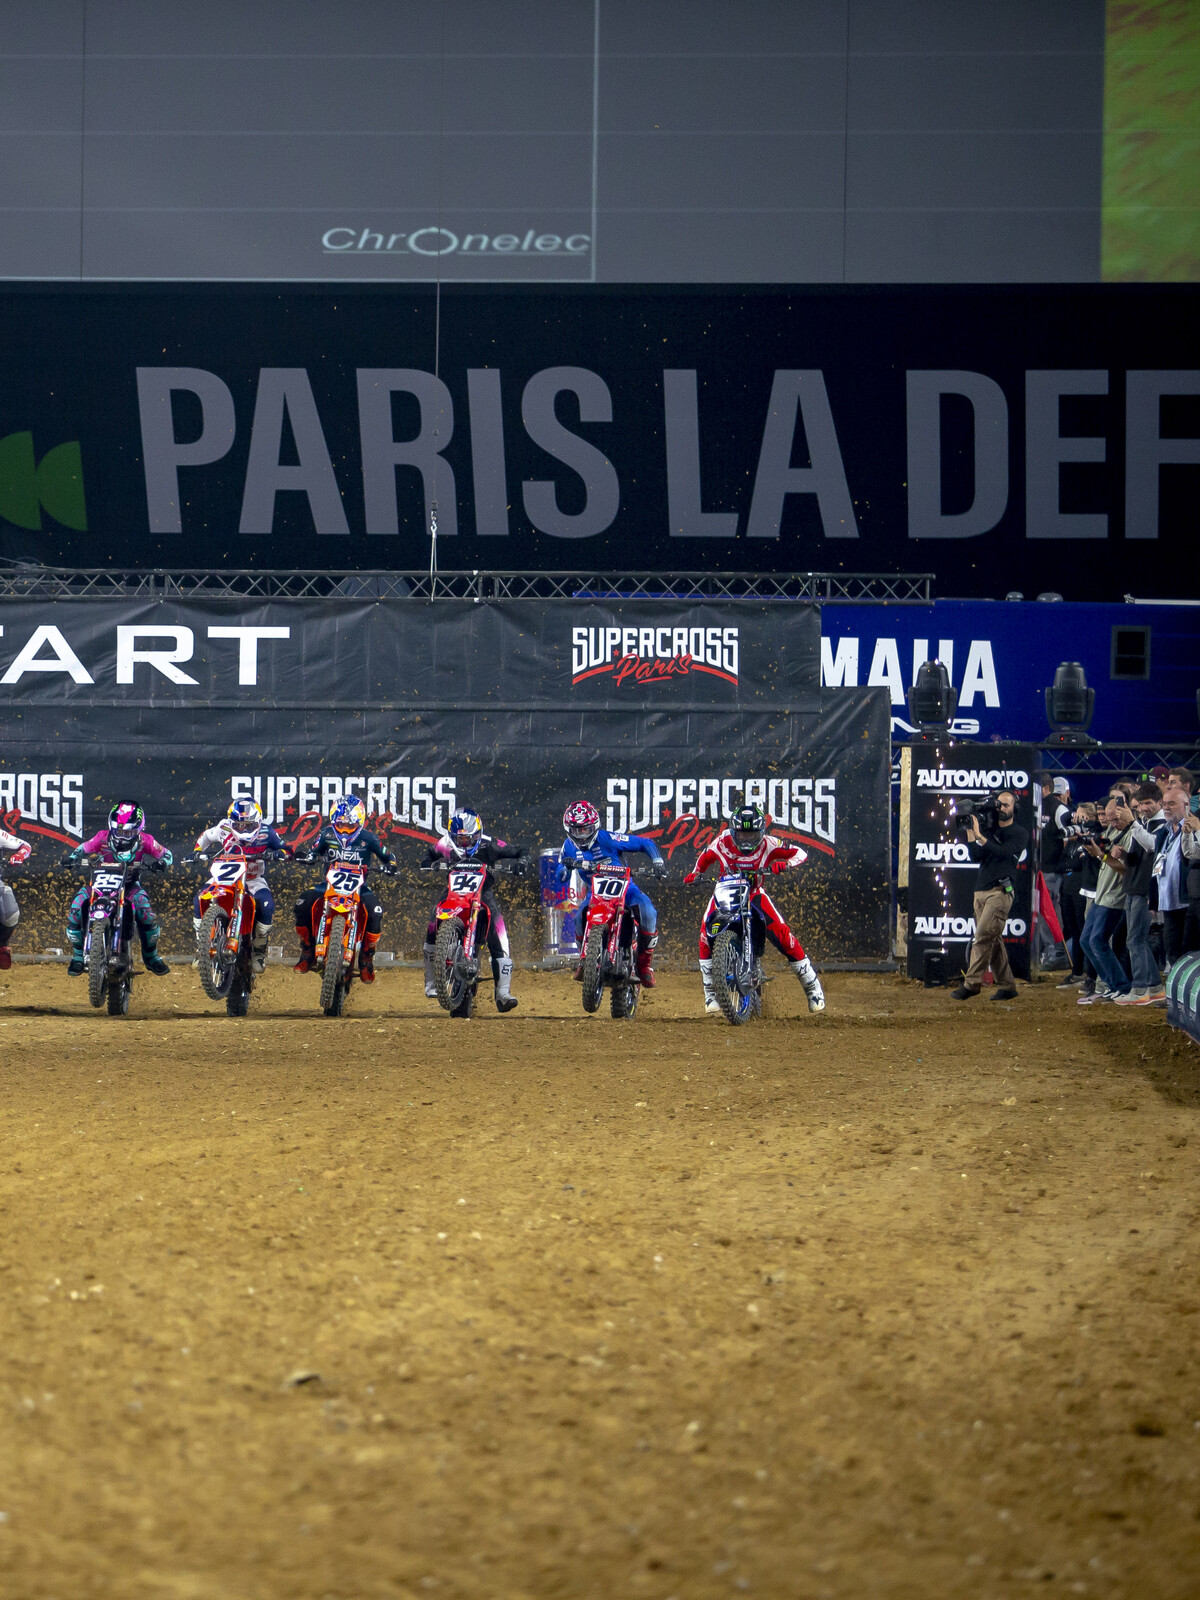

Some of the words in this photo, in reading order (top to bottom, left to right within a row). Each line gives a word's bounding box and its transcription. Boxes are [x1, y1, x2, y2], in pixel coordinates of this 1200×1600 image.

[136, 366, 620, 536] PARIS
[663, 368, 859, 538] LA
[905, 369, 1200, 539] DEF
[572, 627, 738, 676] SUPERCROSS
[612, 653, 692, 687] Paris
[917, 769, 1029, 789] AUTOMOTO
[606, 778, 836, 844] SUPERCROSS
[94, 874, 124, 888] 85
[218, 864, 241, 881] 2
[332, 872, 360, 890] 25
[453, 875, 477, 892] 94
[597, 880, 622, 896] 10
[914, 917, 1027, 936] AUTOMTO
